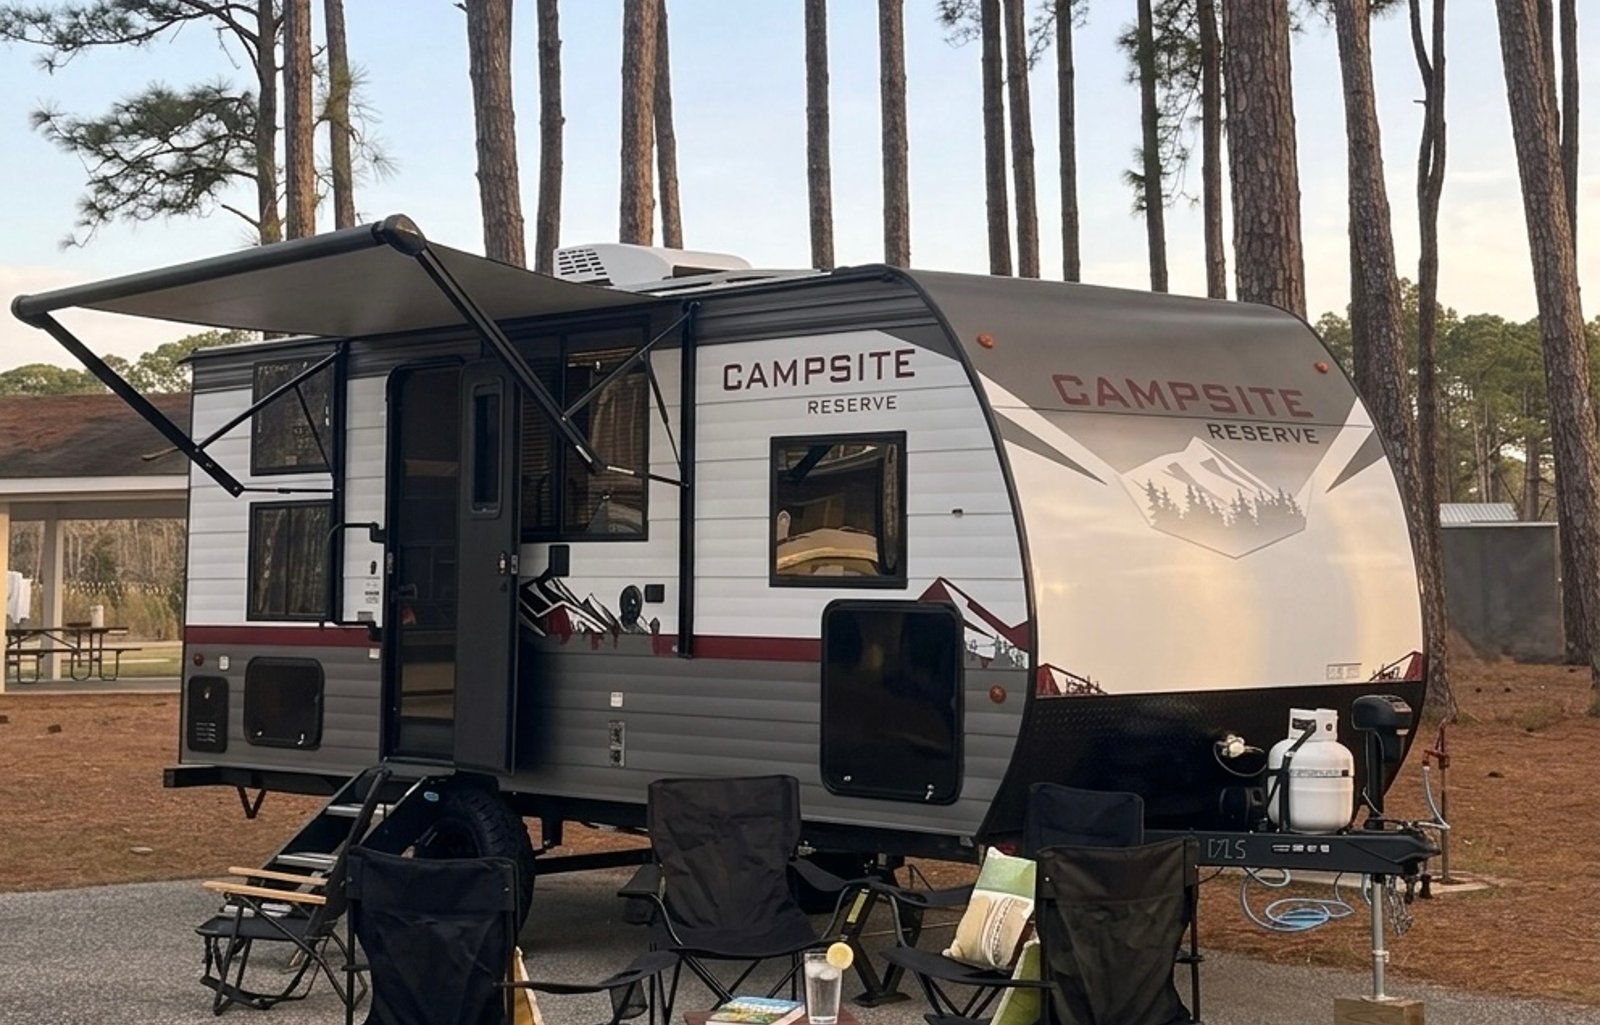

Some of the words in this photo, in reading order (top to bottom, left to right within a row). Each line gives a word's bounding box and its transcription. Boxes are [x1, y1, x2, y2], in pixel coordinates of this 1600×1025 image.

[723, 349, 916, 391] CAMPSITE
[807, 395, 897, 414] RESERVE
[1052, 374, 1314, 418] CAMPSITE
[1207, 423, 1320, 444] RESERVE
